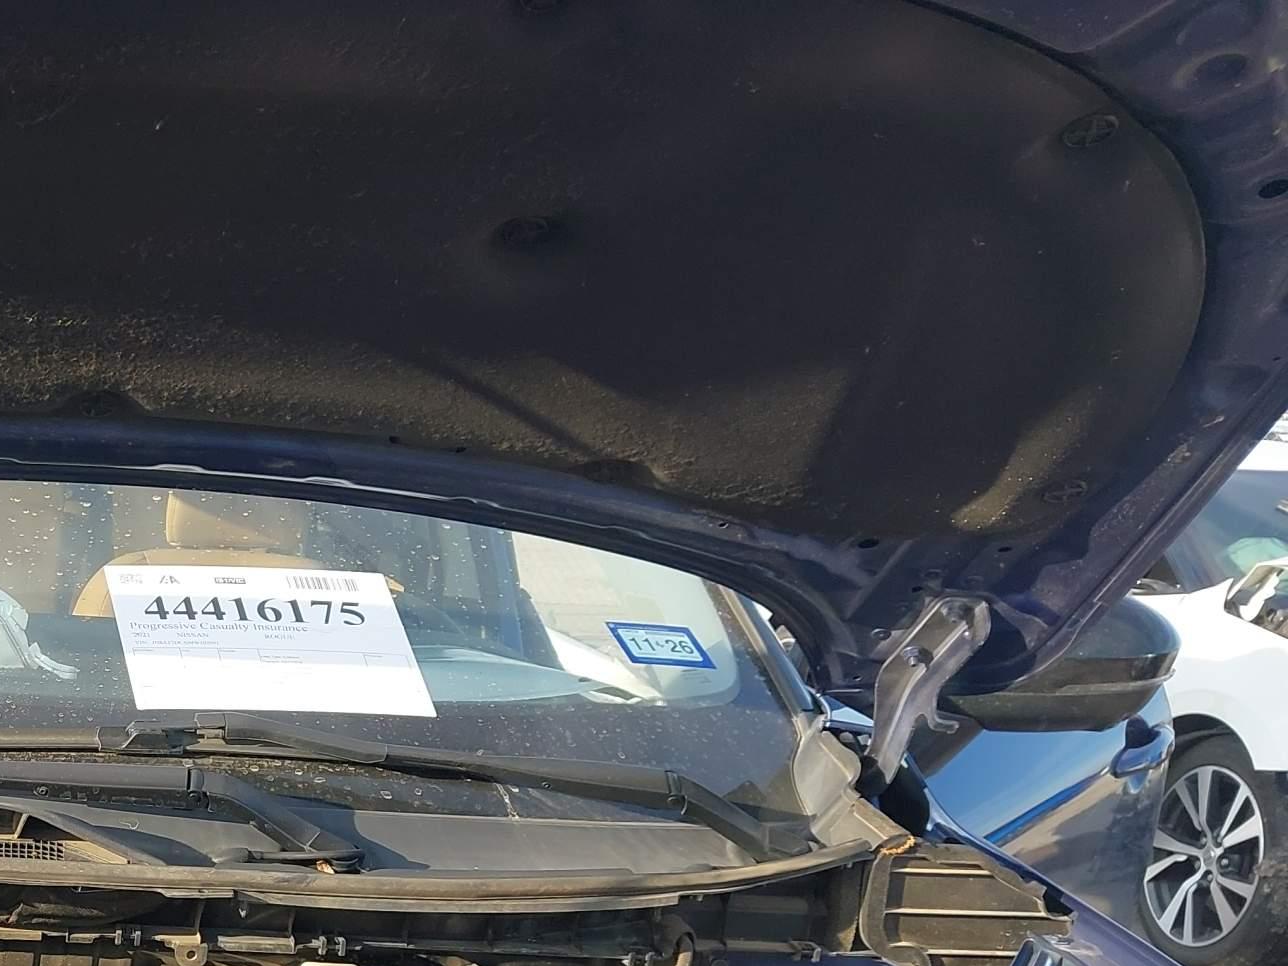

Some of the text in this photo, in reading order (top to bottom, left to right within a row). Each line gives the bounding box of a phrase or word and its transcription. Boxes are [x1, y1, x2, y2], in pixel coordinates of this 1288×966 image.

[144, 595, 366, 626] 44416175
[130, 621, 309, 633] Progressive Casualty Insurance
